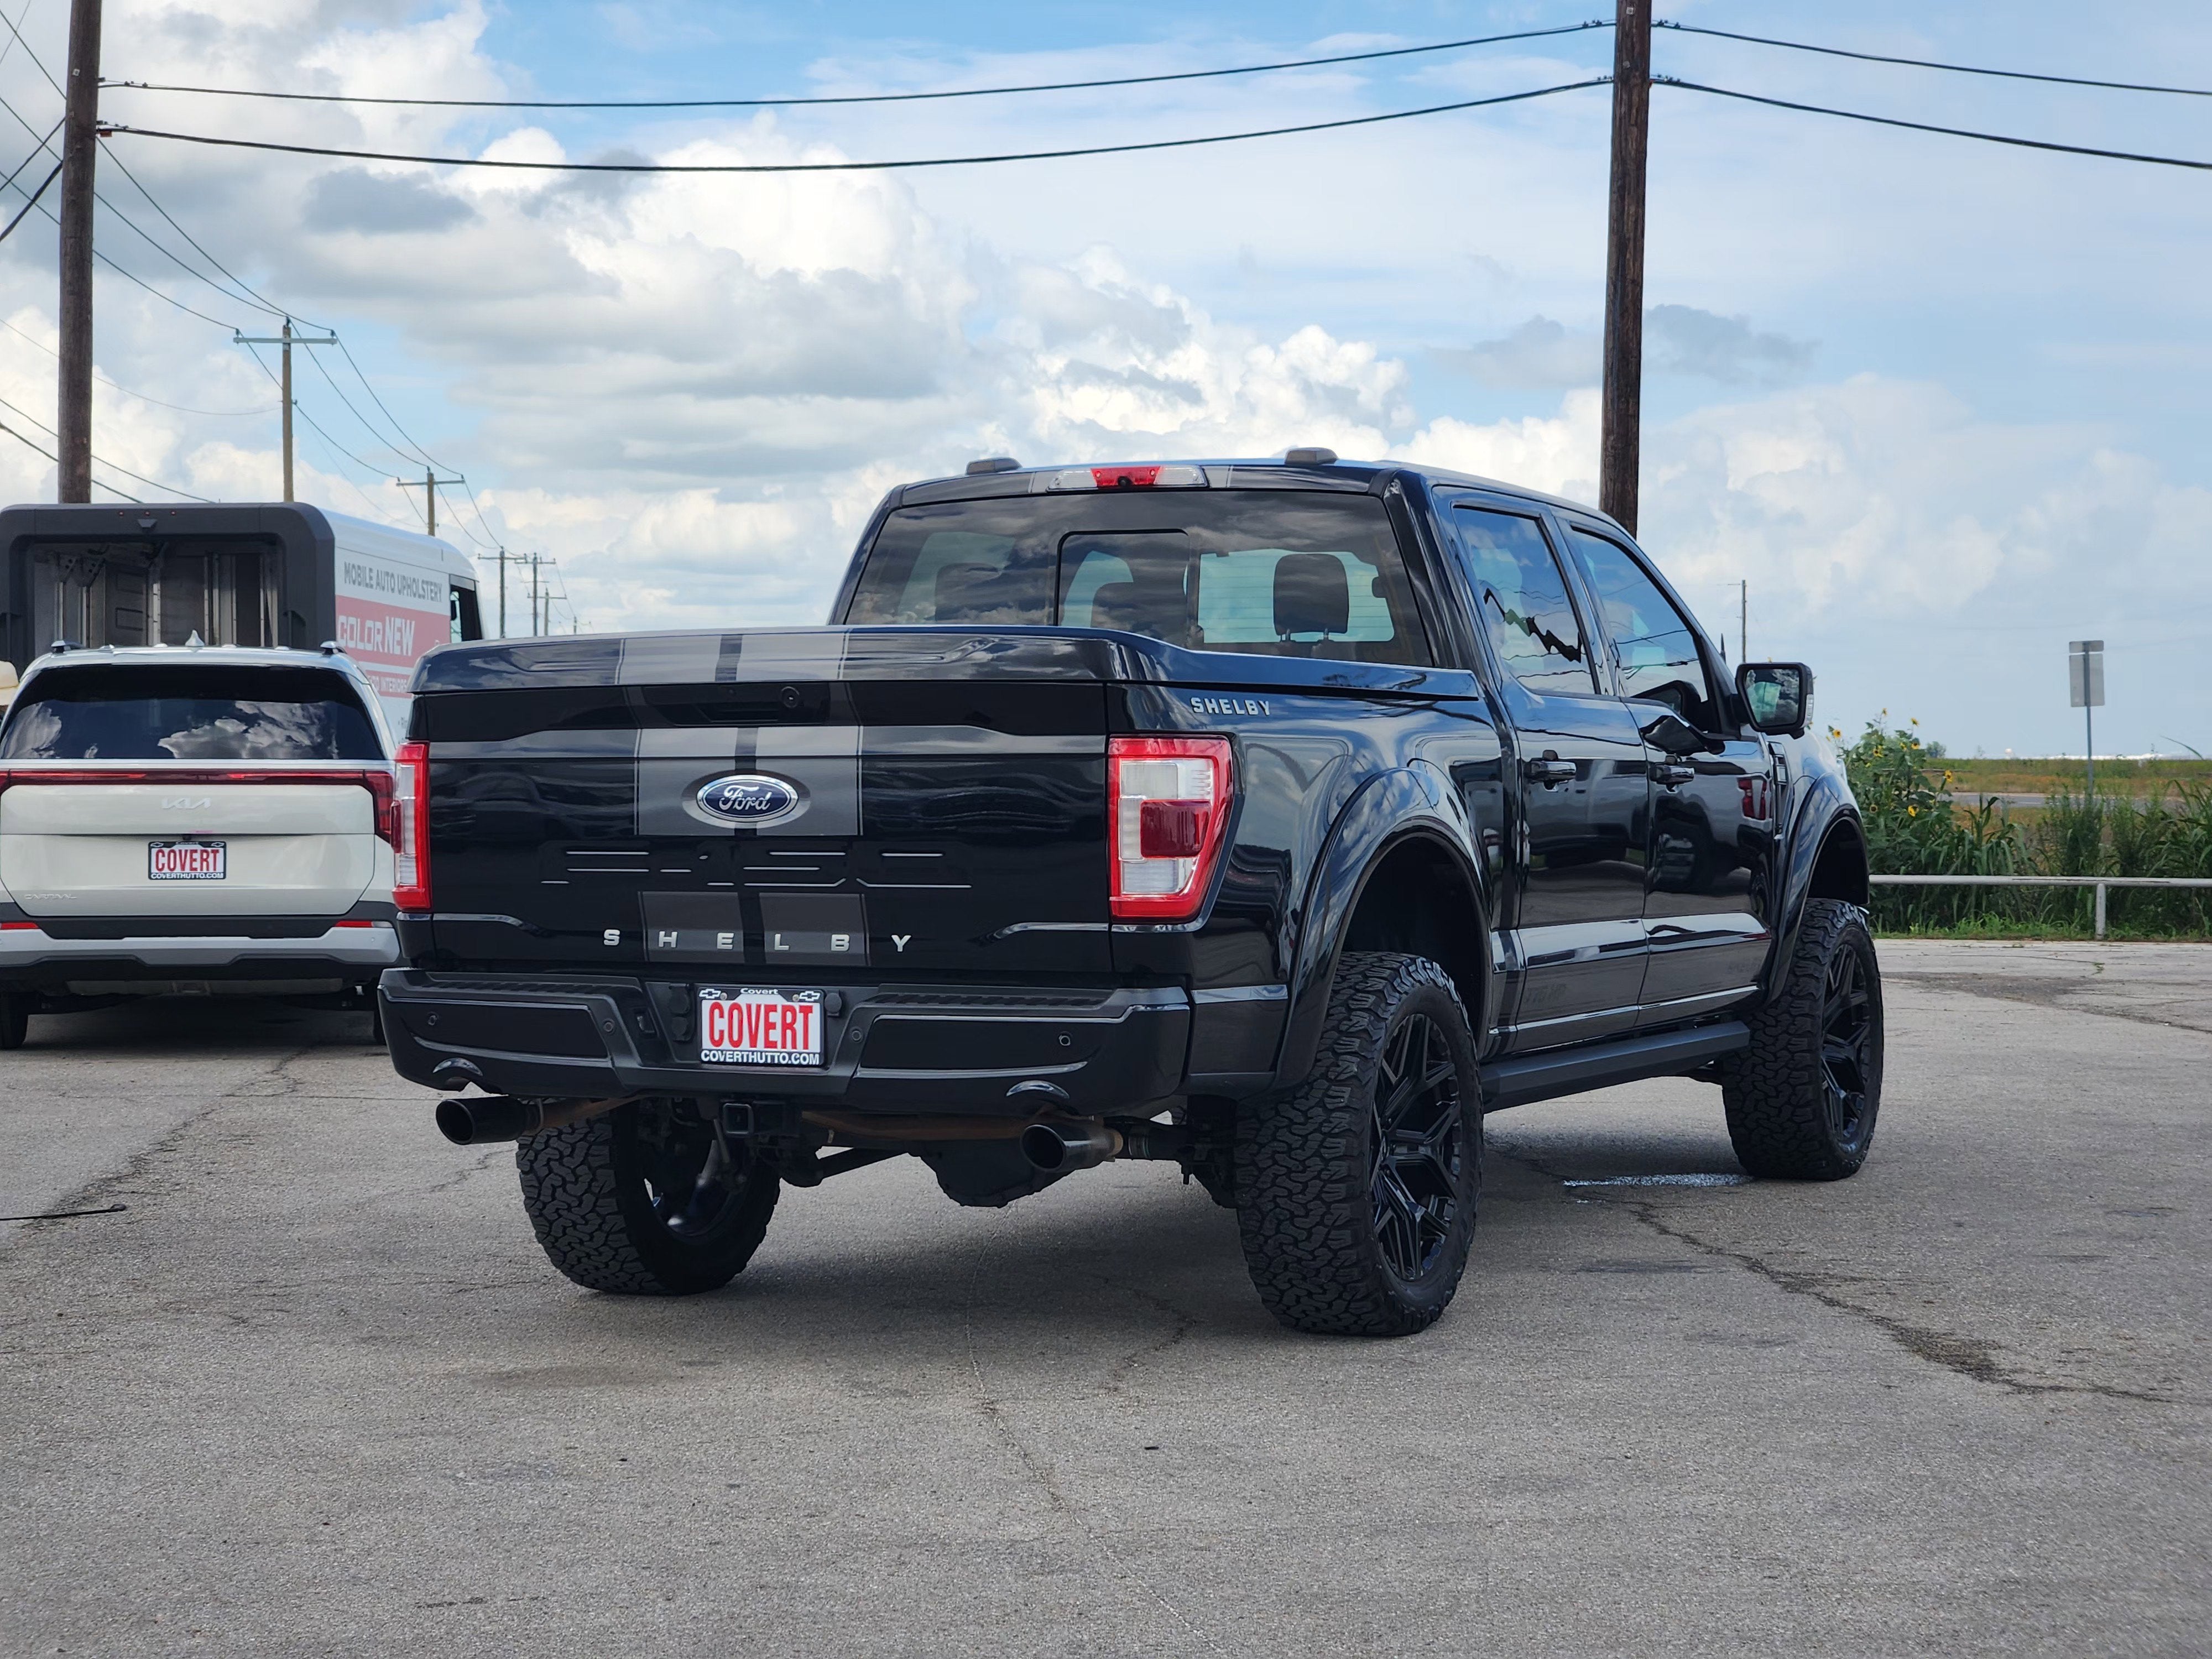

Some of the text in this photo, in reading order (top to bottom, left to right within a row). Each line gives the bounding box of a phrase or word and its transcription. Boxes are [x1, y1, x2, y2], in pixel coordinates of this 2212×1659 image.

[344, 561, 442, 602] MOBILE AUTO UPHOLSTERY
[1191, 697, 1270, 716] SHELBY
[719, 785, 772, 810] Ford
[155, 848, 220, 872] COVERT
[603, 929, 911, 952] SHELBY
[709, 1001, 813, 1050] COVERT
[701, 1050, 820, 1065] COVERTHUTTO.COM
